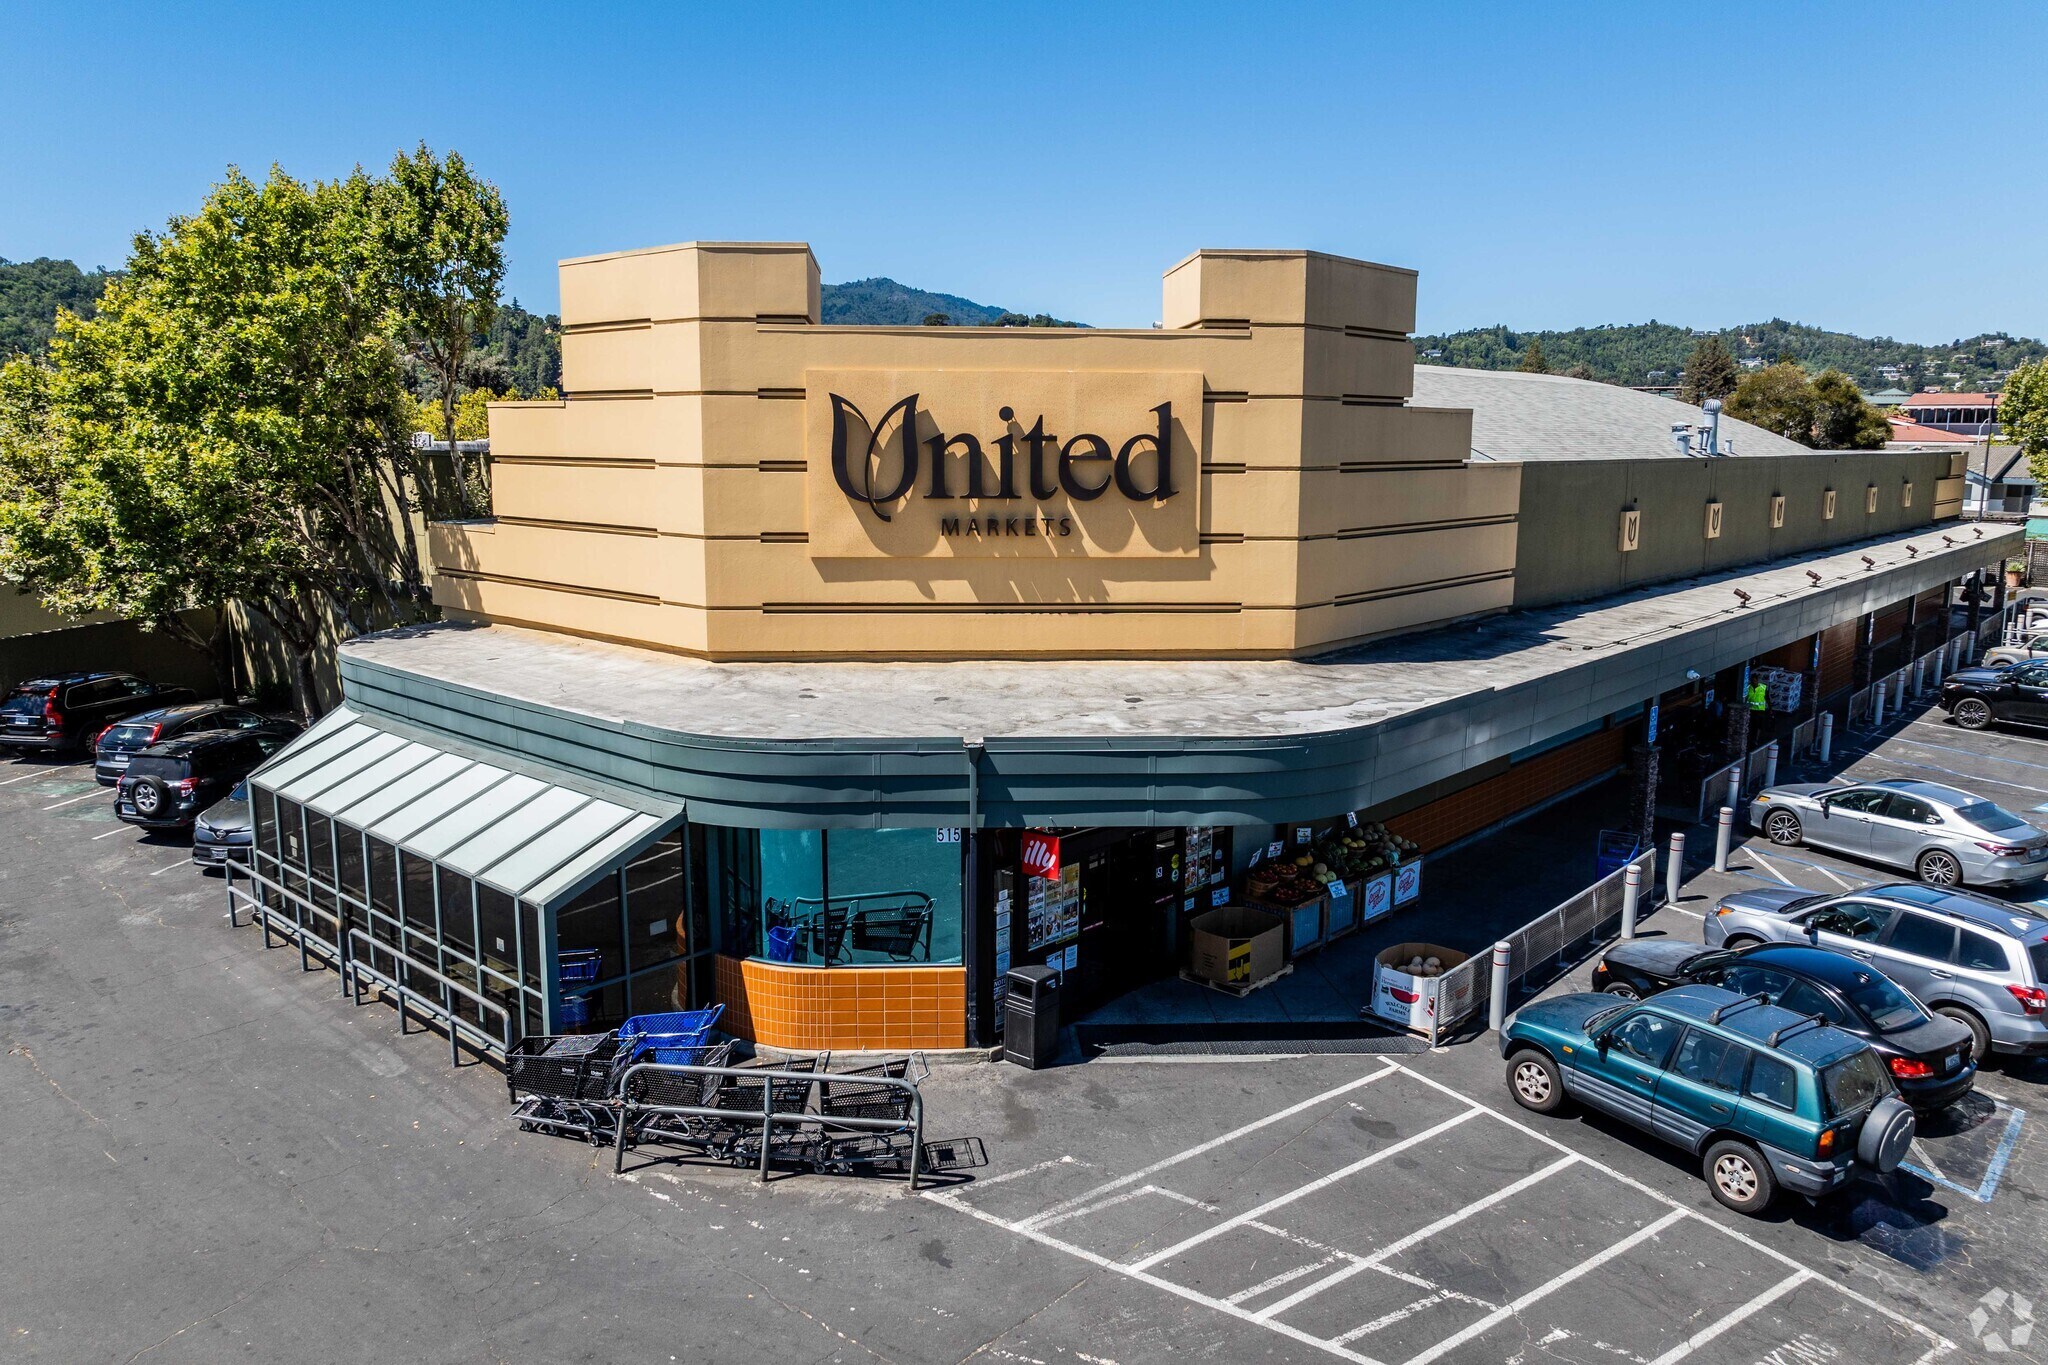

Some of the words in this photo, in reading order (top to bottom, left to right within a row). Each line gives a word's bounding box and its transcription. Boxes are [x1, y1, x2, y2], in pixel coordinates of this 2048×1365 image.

[829, 392, 1180, 523] United
[941, 517, 1071, 537] MARKETS
[937, 827, 961, 842] 515
[1024, 840, 1057, 874] illy
